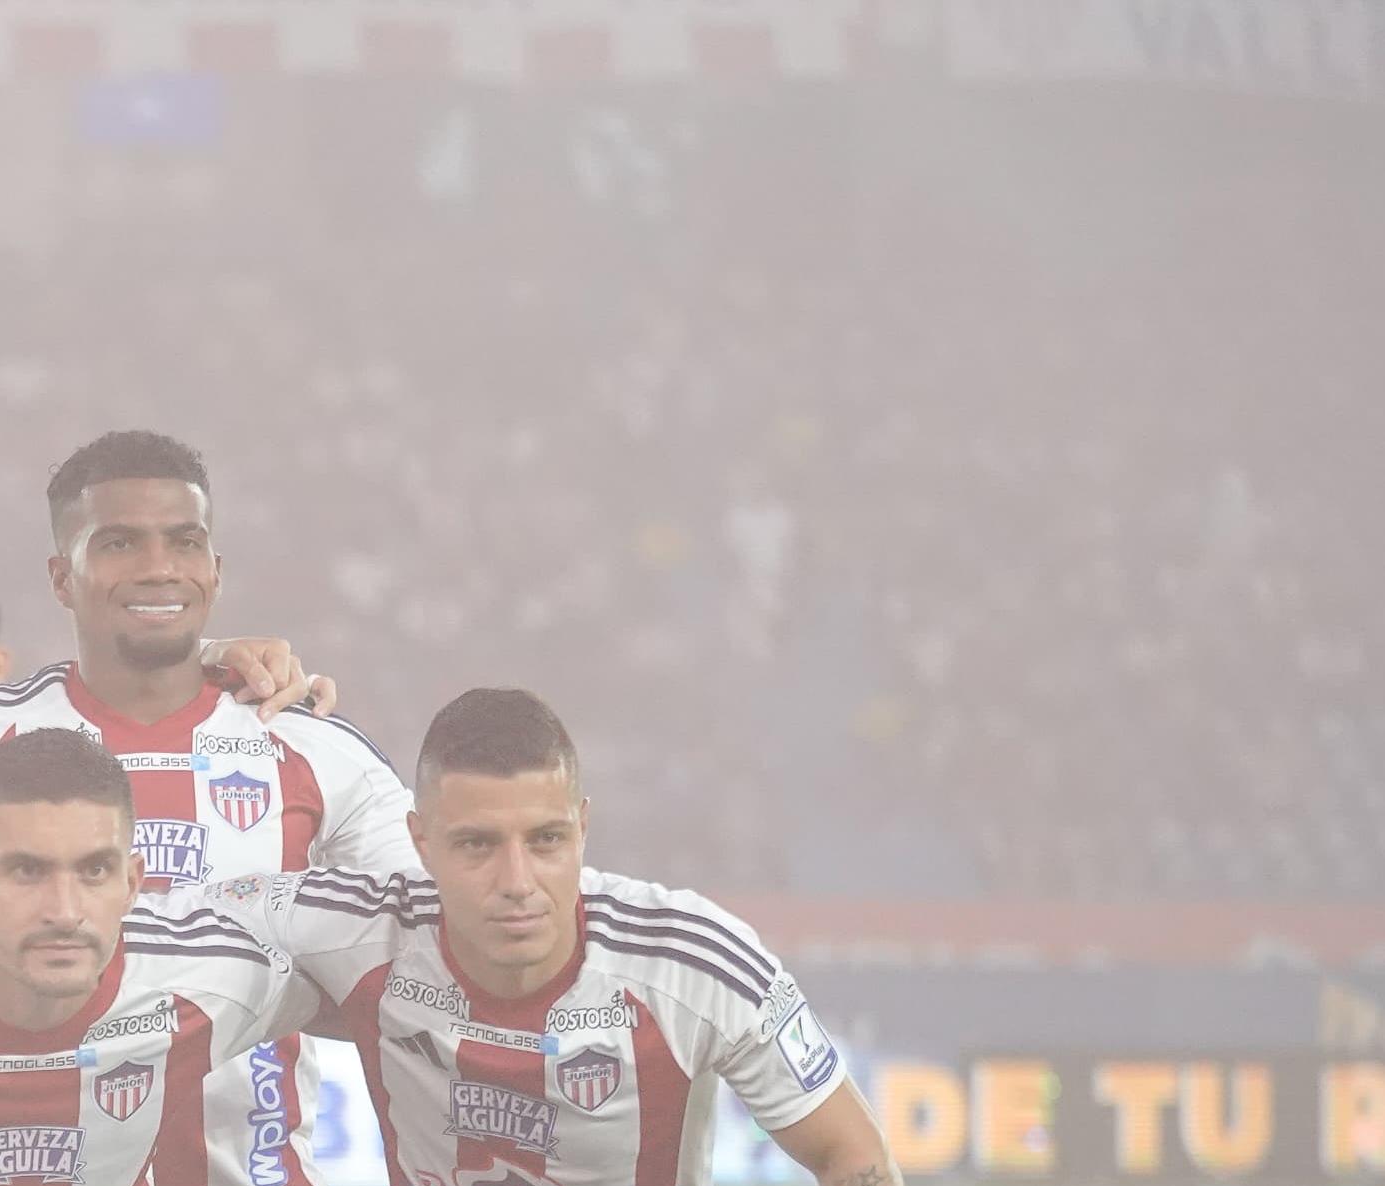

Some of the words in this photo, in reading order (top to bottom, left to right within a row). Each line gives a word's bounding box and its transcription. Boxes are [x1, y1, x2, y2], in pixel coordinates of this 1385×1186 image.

[218, 791, 262, 801] JUNIOR
[566, 1067, 612, 1082] JUNIOR
[102, 1077, 146, 1094] JUNIOR
[457, 1105, 546, 1145] AGUILA
[1092, 1058, 1274, 1178] TU
